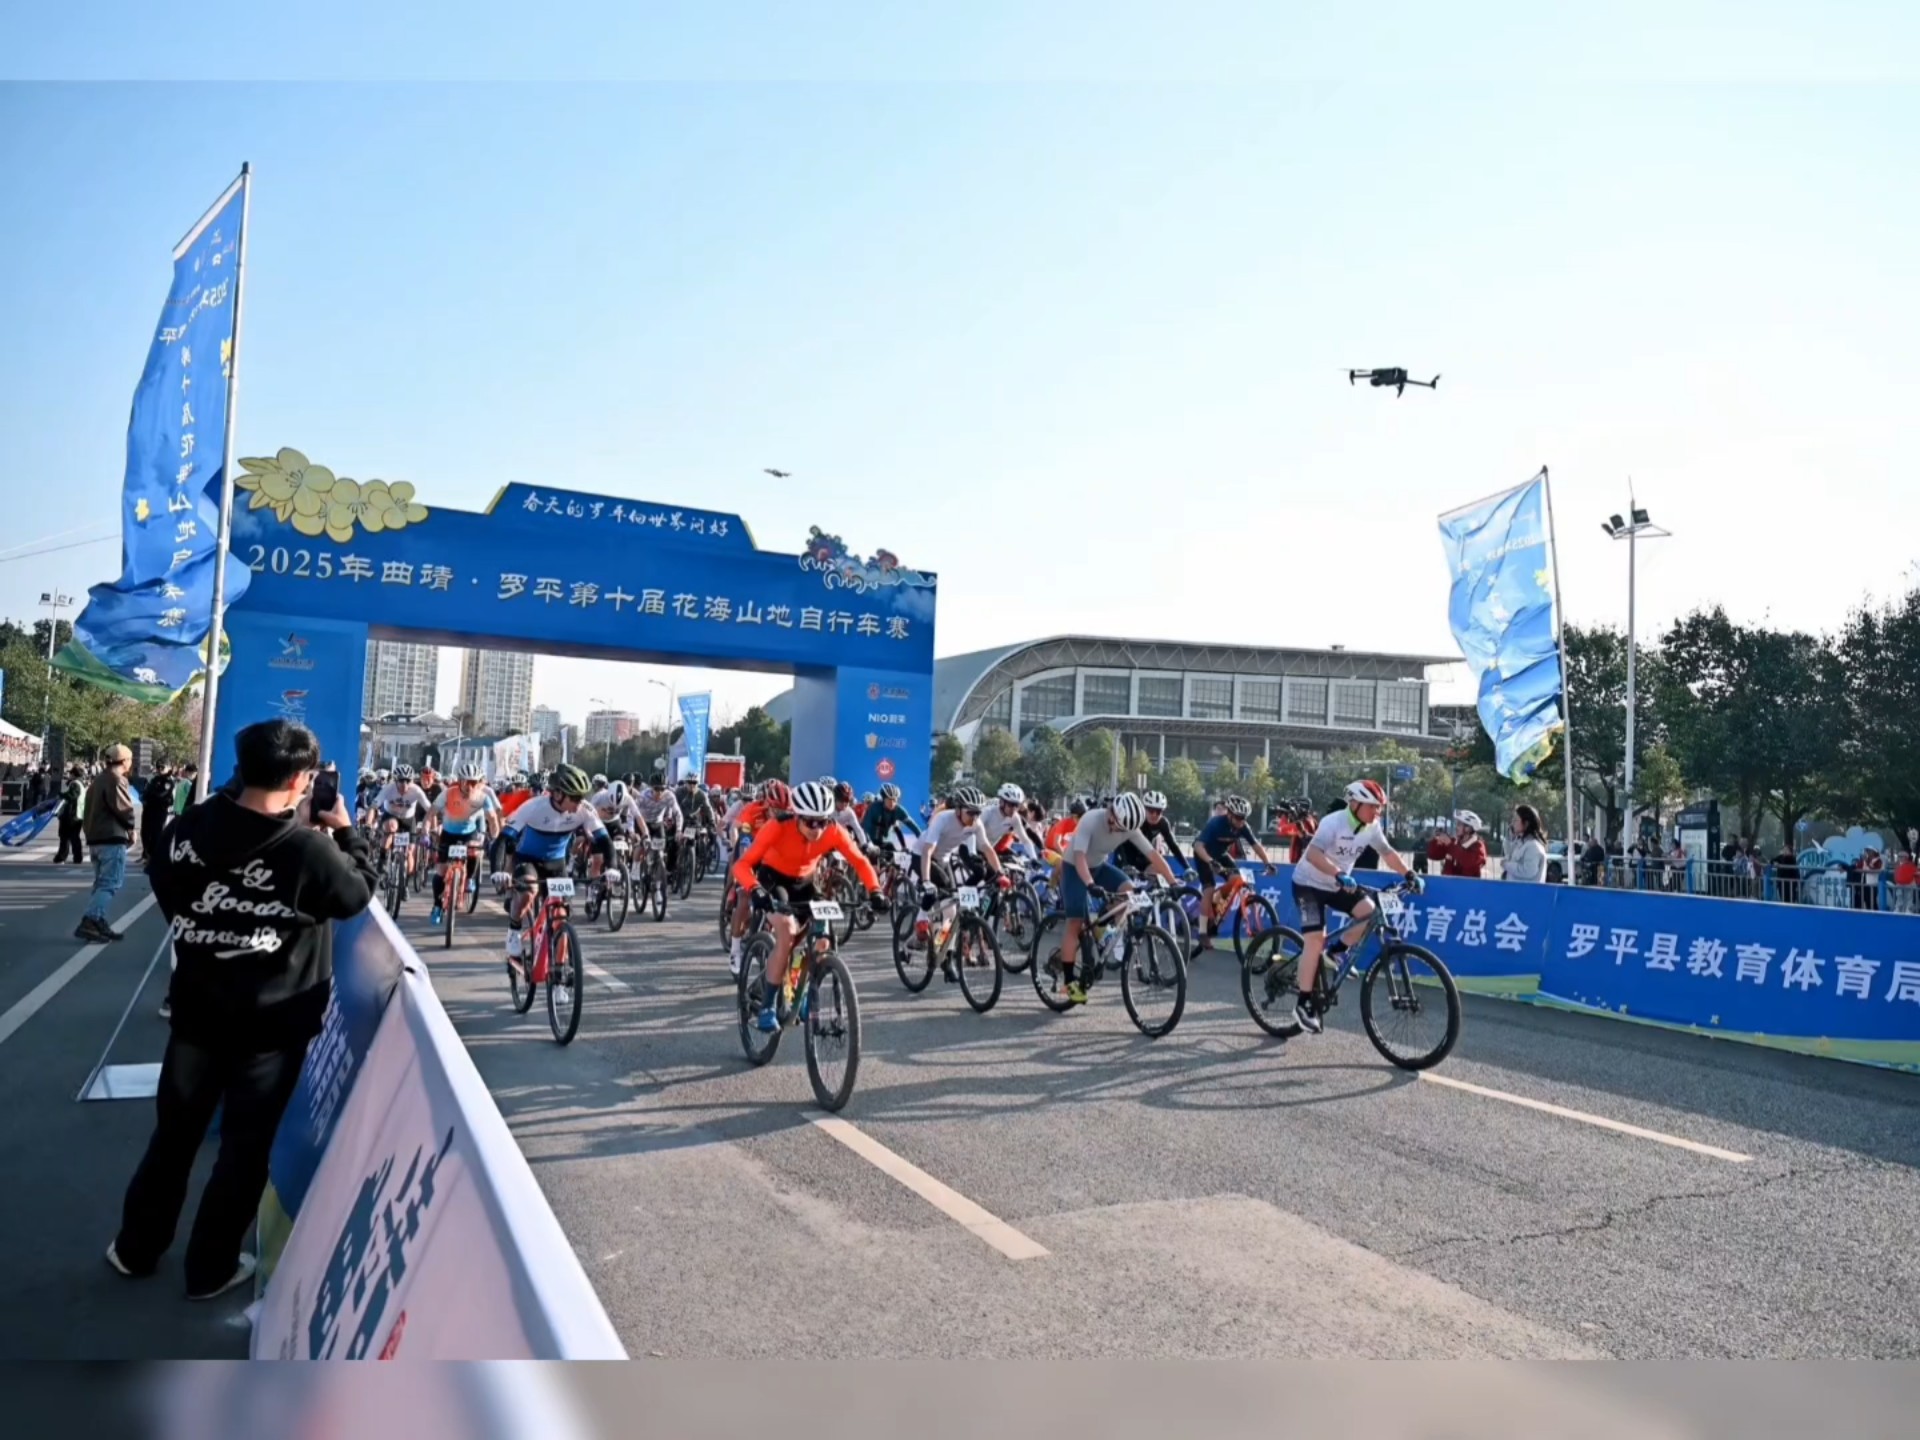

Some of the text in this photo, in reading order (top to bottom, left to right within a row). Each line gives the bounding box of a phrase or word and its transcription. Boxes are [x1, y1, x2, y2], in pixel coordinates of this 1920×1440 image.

[522, 491, 729, 537] 春天的罗平向世界问好
[550, 883, 572, 893] 208
[1566, 922, 1920, 1005] 罗平县教育体育局
